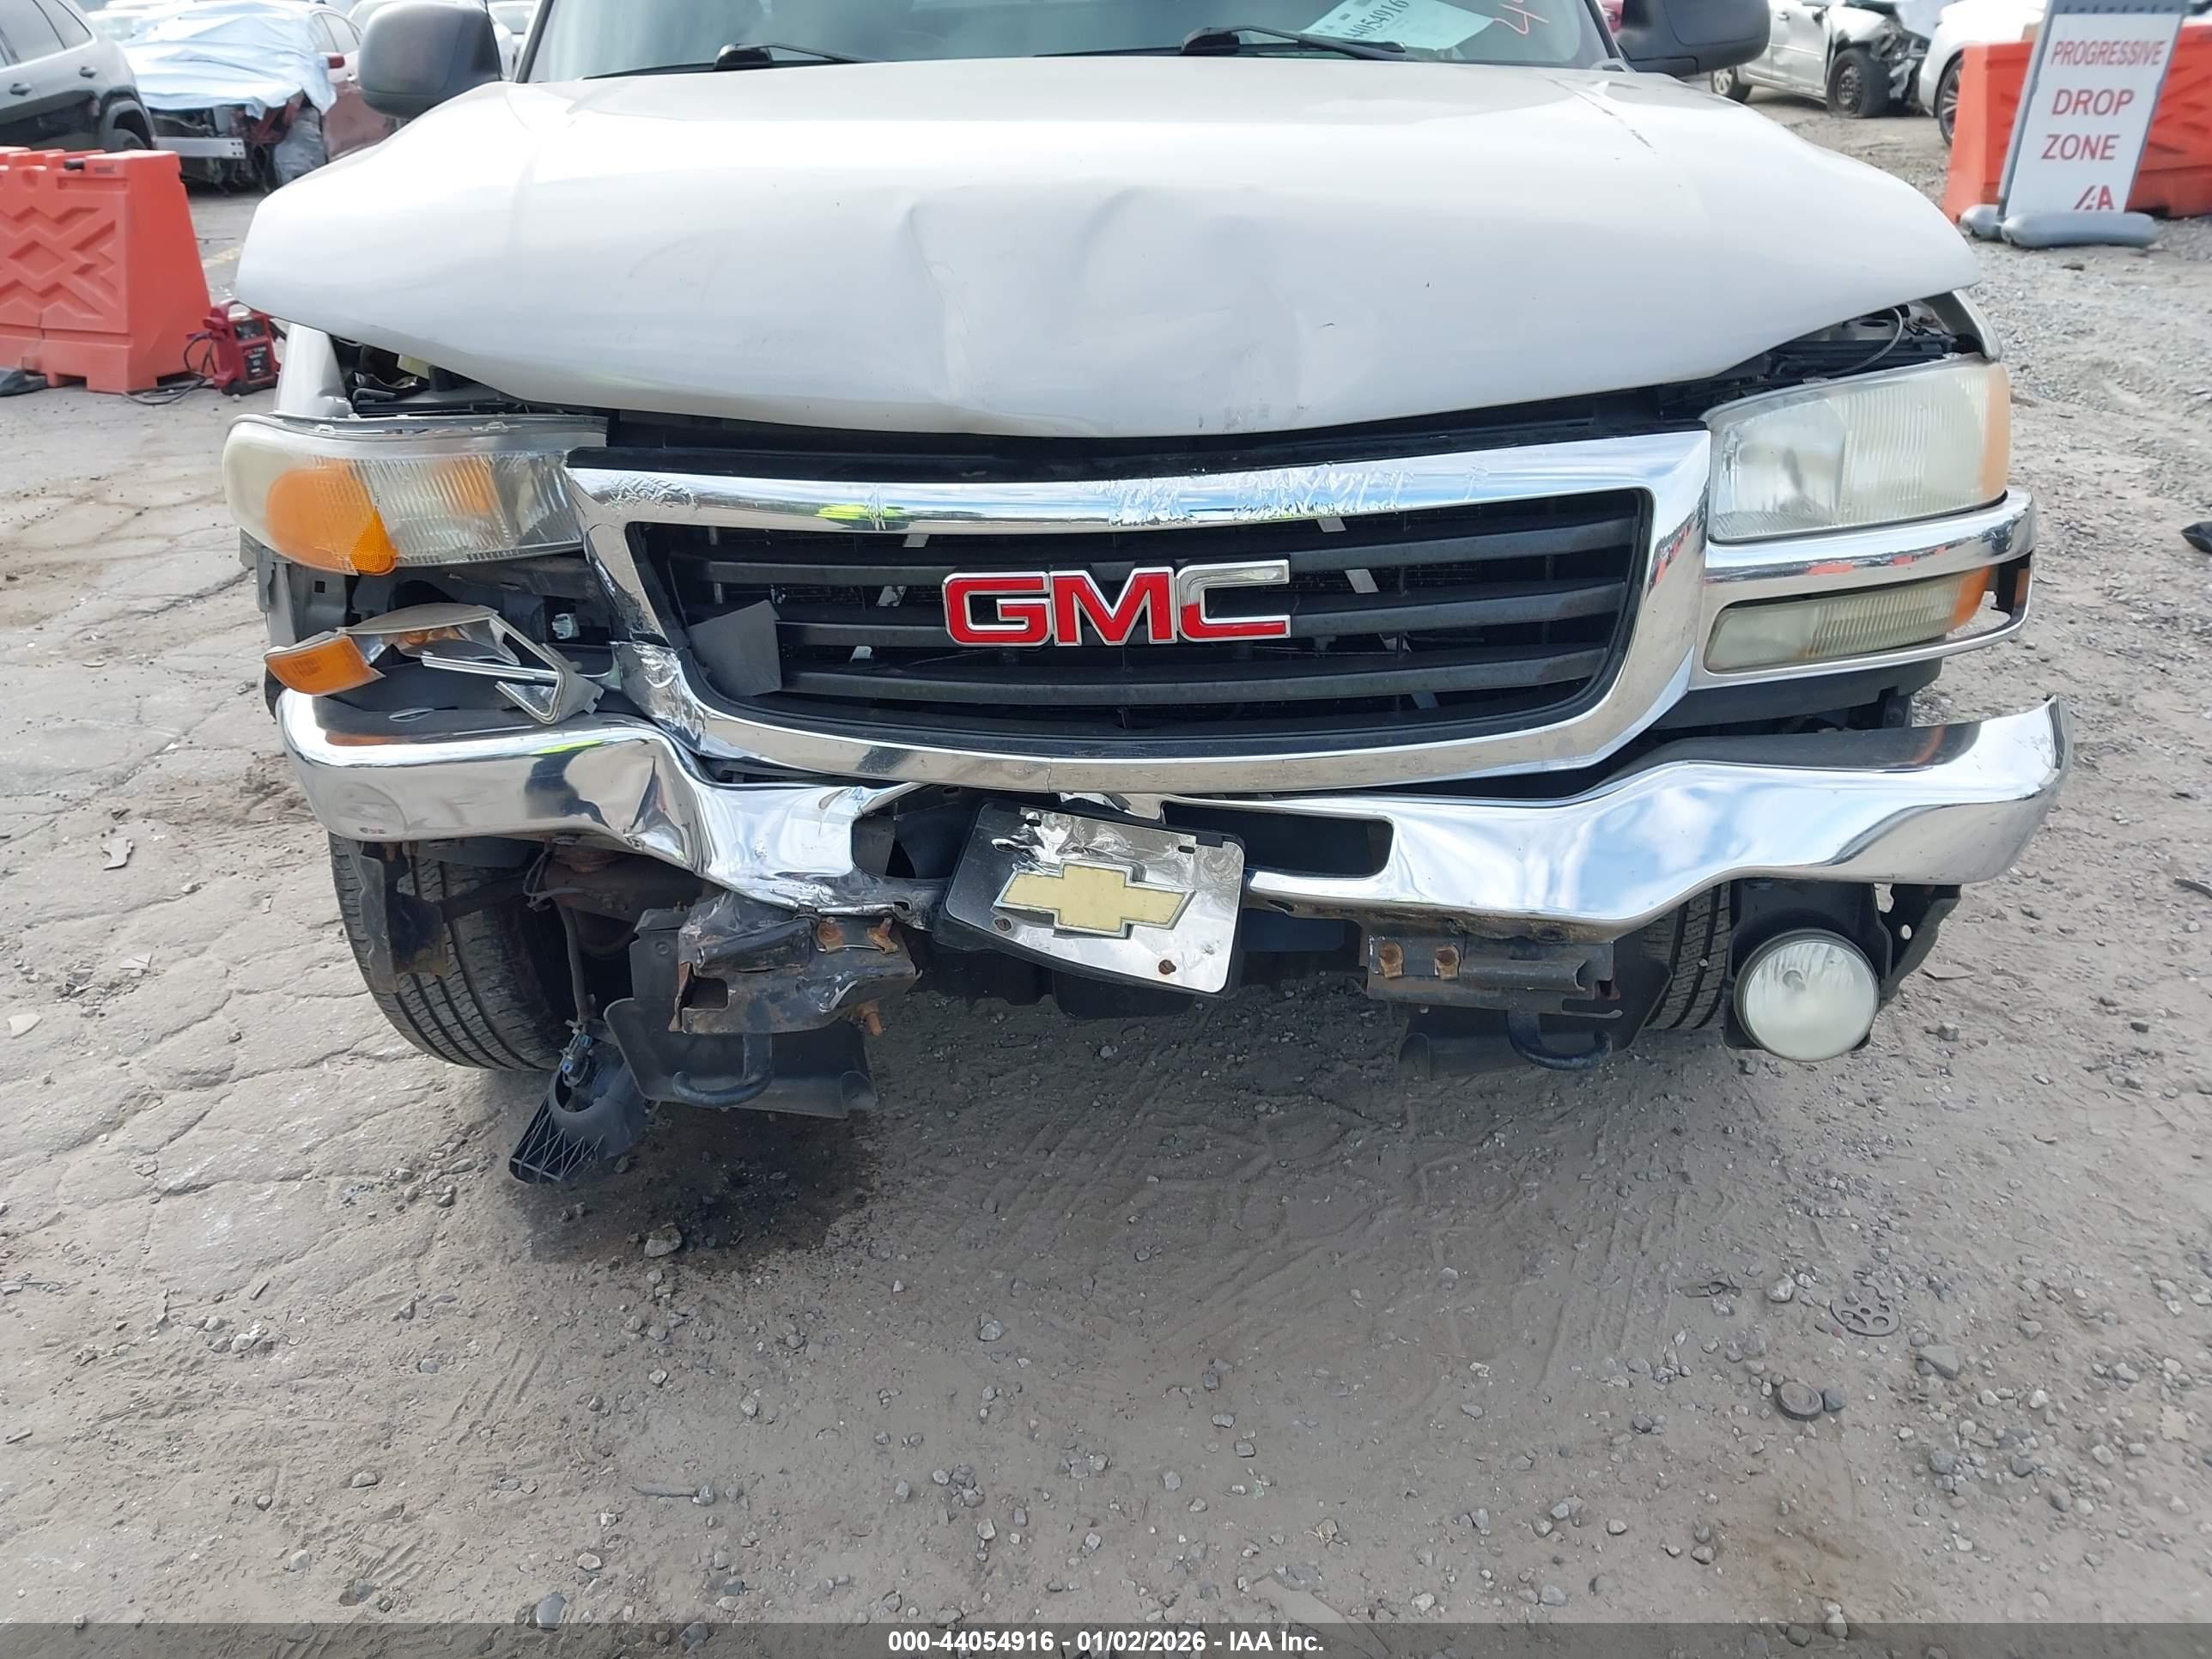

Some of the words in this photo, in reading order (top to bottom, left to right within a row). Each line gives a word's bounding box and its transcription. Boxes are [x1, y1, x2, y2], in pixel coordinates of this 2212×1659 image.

[2050, 40, 2167, 66] PROGRESSIVE
[2051, 88, 2135, 116] DROP
[2041, 134, 2120, 161] ZONE
[942, 559, 1291, 647] GMC
